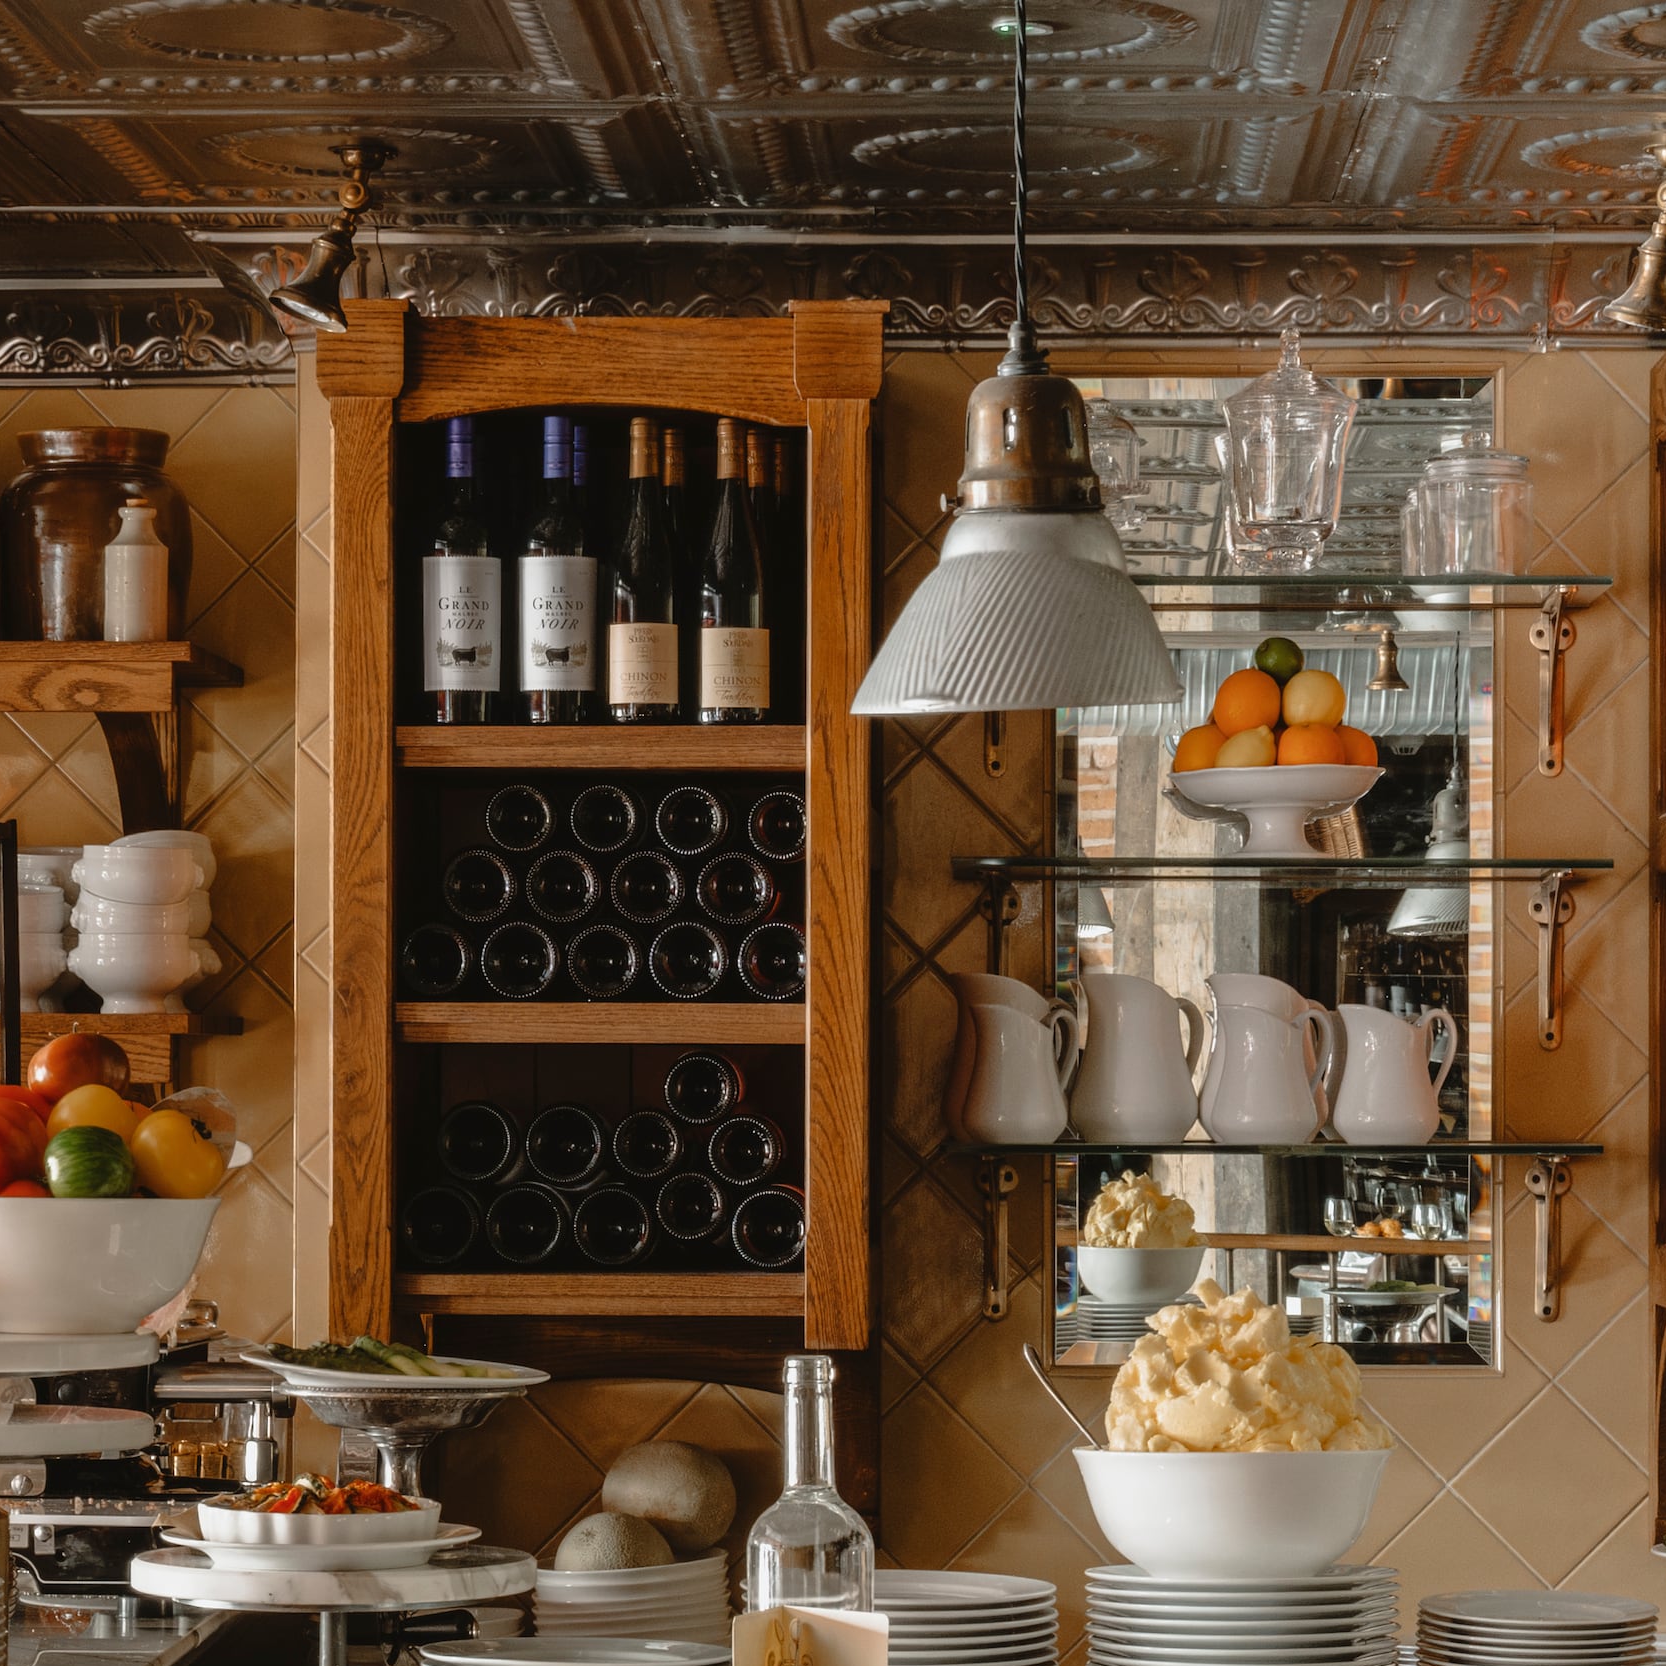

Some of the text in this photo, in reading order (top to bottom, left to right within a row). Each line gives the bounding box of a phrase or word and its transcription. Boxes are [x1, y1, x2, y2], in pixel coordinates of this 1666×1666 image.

[459, 586, 473, 594] LE
[552, 586, 566, 594] LE
[439, 597, 489, 611] GRAND
[533, 597, 583, 611] GRAND
[443, 619, 485, 630] NOIR
[536, 619, 579, 630] NOIR
[620, 672, 667, 681] CHINON
[713, 676, 761, 685] CHINON
